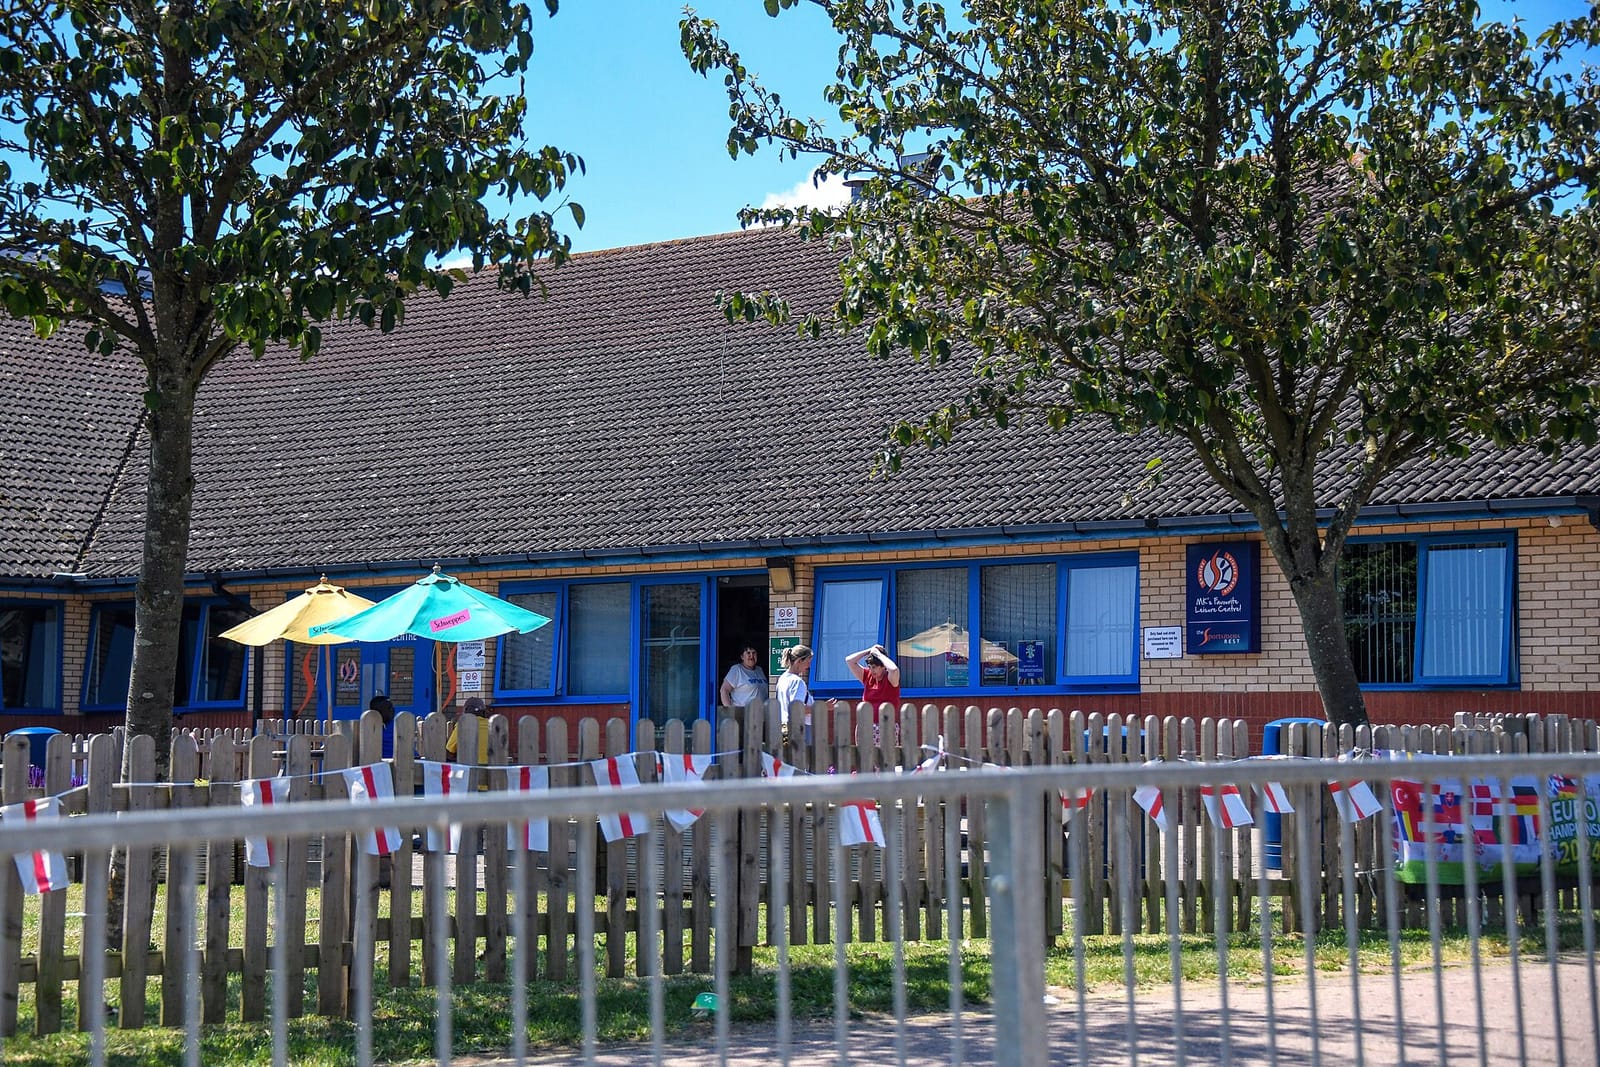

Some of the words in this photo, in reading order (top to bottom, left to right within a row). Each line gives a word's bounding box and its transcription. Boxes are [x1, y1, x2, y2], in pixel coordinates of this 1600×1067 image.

[1213, 597, 1239, 605] Favourite
[1194, 605, 1217, 613] Leisure
[433, 615, 466, 628] Schweppes
[1559, 839, 1600, 864] 204
